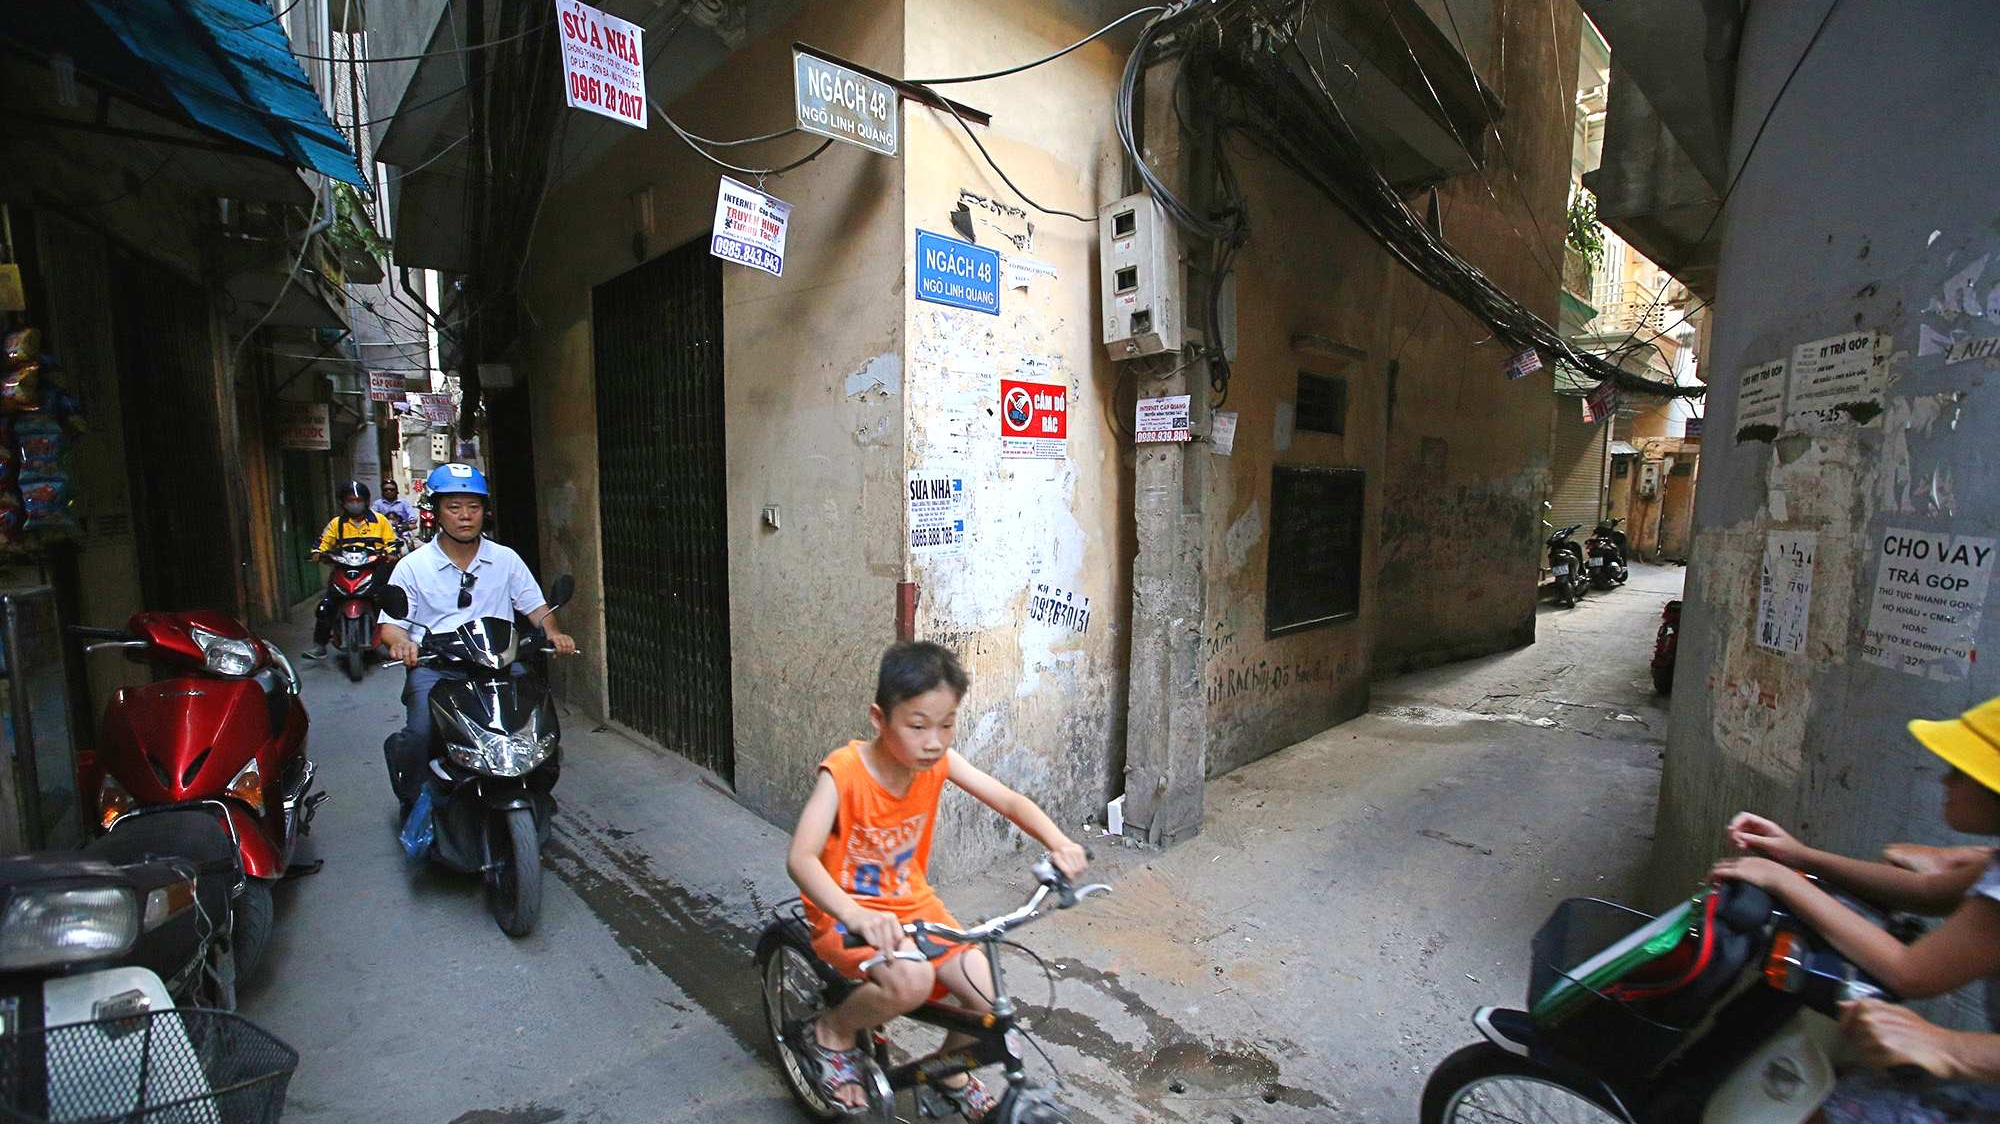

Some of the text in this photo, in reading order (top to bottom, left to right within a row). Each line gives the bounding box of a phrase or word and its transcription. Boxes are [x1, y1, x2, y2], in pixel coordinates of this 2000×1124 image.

[603, 26, 640, 67] NHÀ
[571, 71, 643, 121] 0961 28 2017
[808, 66, 887, 121] NGÁCH 48
[802, 104, 893, 146] NGÕ LINH QUANG
[724, 193, 757, 212] INTERNET
[714, 240, 781, 272] 0985.843.643
[926, 247, 992, 284] NGÁCH 48
[923, 276, 994, 305] NGÕ LINH QUANG
[1848, 336, 1871, 352] GÓP
[1041, 414, 1059, 434] RÁC
[910, 472, 951, 501] SỬA NHÀ
[1884, 534, 1992, 568] CHO VAY
[1887, 566, 1970, 592] TRẢ GÓP
[1896, 590, 1913, 602] TỤC
[1914, 593, 1948, 607] NHANH
